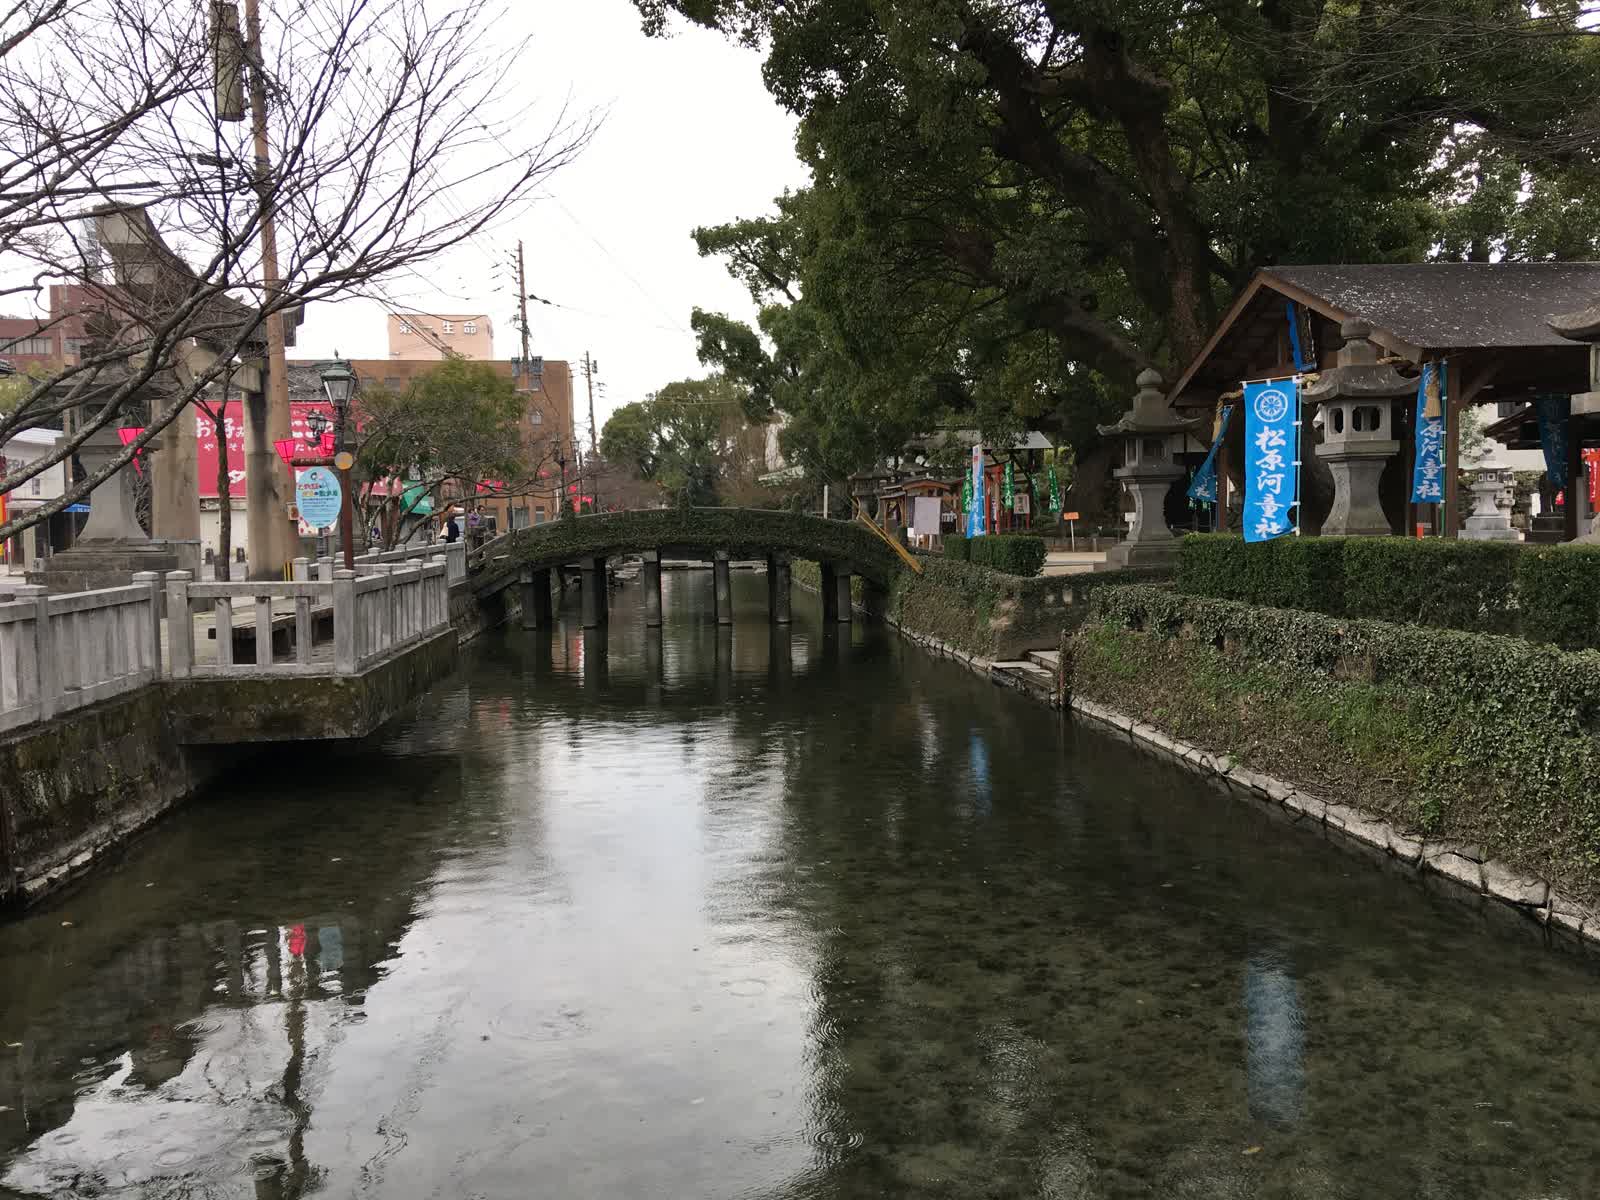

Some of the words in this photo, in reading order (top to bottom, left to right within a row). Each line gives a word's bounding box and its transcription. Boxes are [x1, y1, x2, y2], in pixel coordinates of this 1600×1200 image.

[399, 320, 477, 334] 第一生命
[1254, 425, 1286, 539] 松原河童社
[1416, 407, 1442, 498] 原河童社
